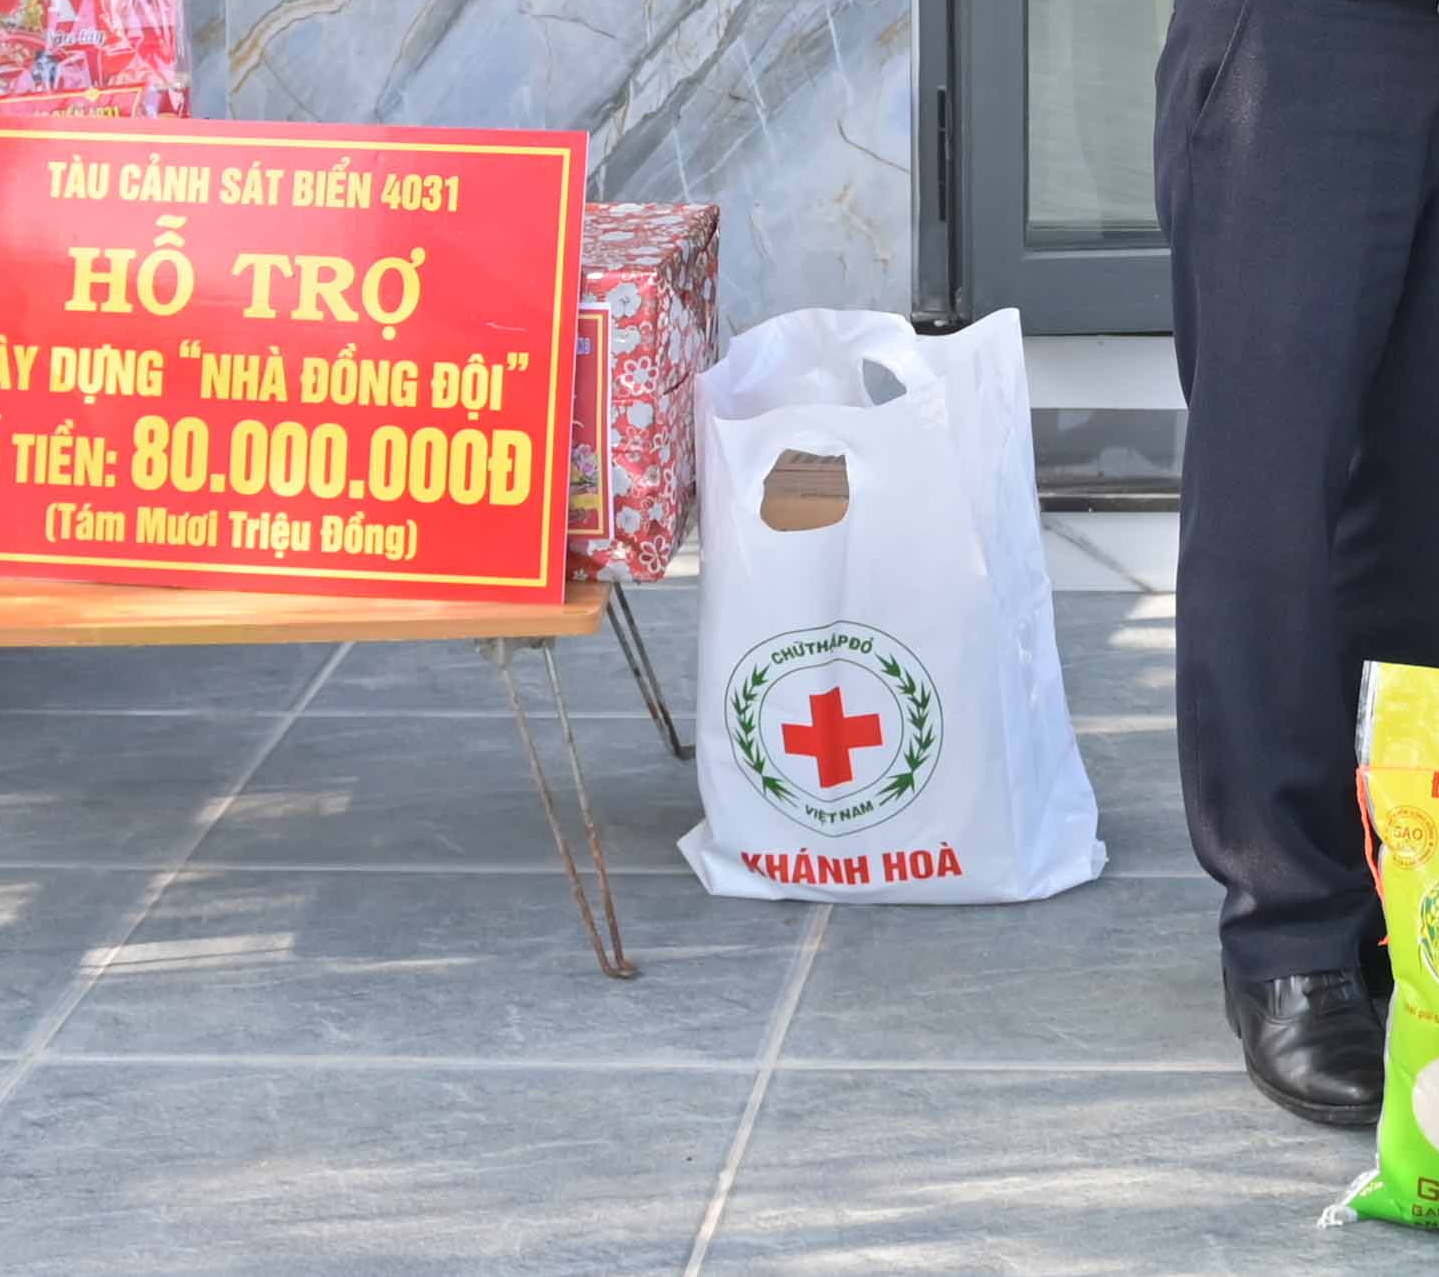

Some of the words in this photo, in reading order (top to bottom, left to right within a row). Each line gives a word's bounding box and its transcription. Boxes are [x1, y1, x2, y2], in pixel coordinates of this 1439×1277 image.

[49, 159, 115, 201] TÀU
[120, 152, 207, 204] CẢNH
[220, 163, 281, 207] SÁT
[294, 156, 371, 210] BIỂN
[380, 176, 459, 212] 4031
[65, 216, 196, 317] HỖ
[233, 247, 426, 340] TRỢ
[50, 343, 162, 408] DỰNG
[300, 342, 418, 408] ĐỒNG
[11, 417, 117, 488] TIỀN:
[131, 416, 533, 506] 80.000.000Đ
[45, 500, 125, 546] (Tám
[135, 504, 218, 548] Mươi
[230, 507, 309, 561] Triệu
[320, 511, 417, 561] Đồng)
[805, 804, 837, 824] VIỆT
[840, 800, 874, 820] NAM
[740, 847, 870, 885] KHÁNH
[882, 842, 963, 881] HOÀ
